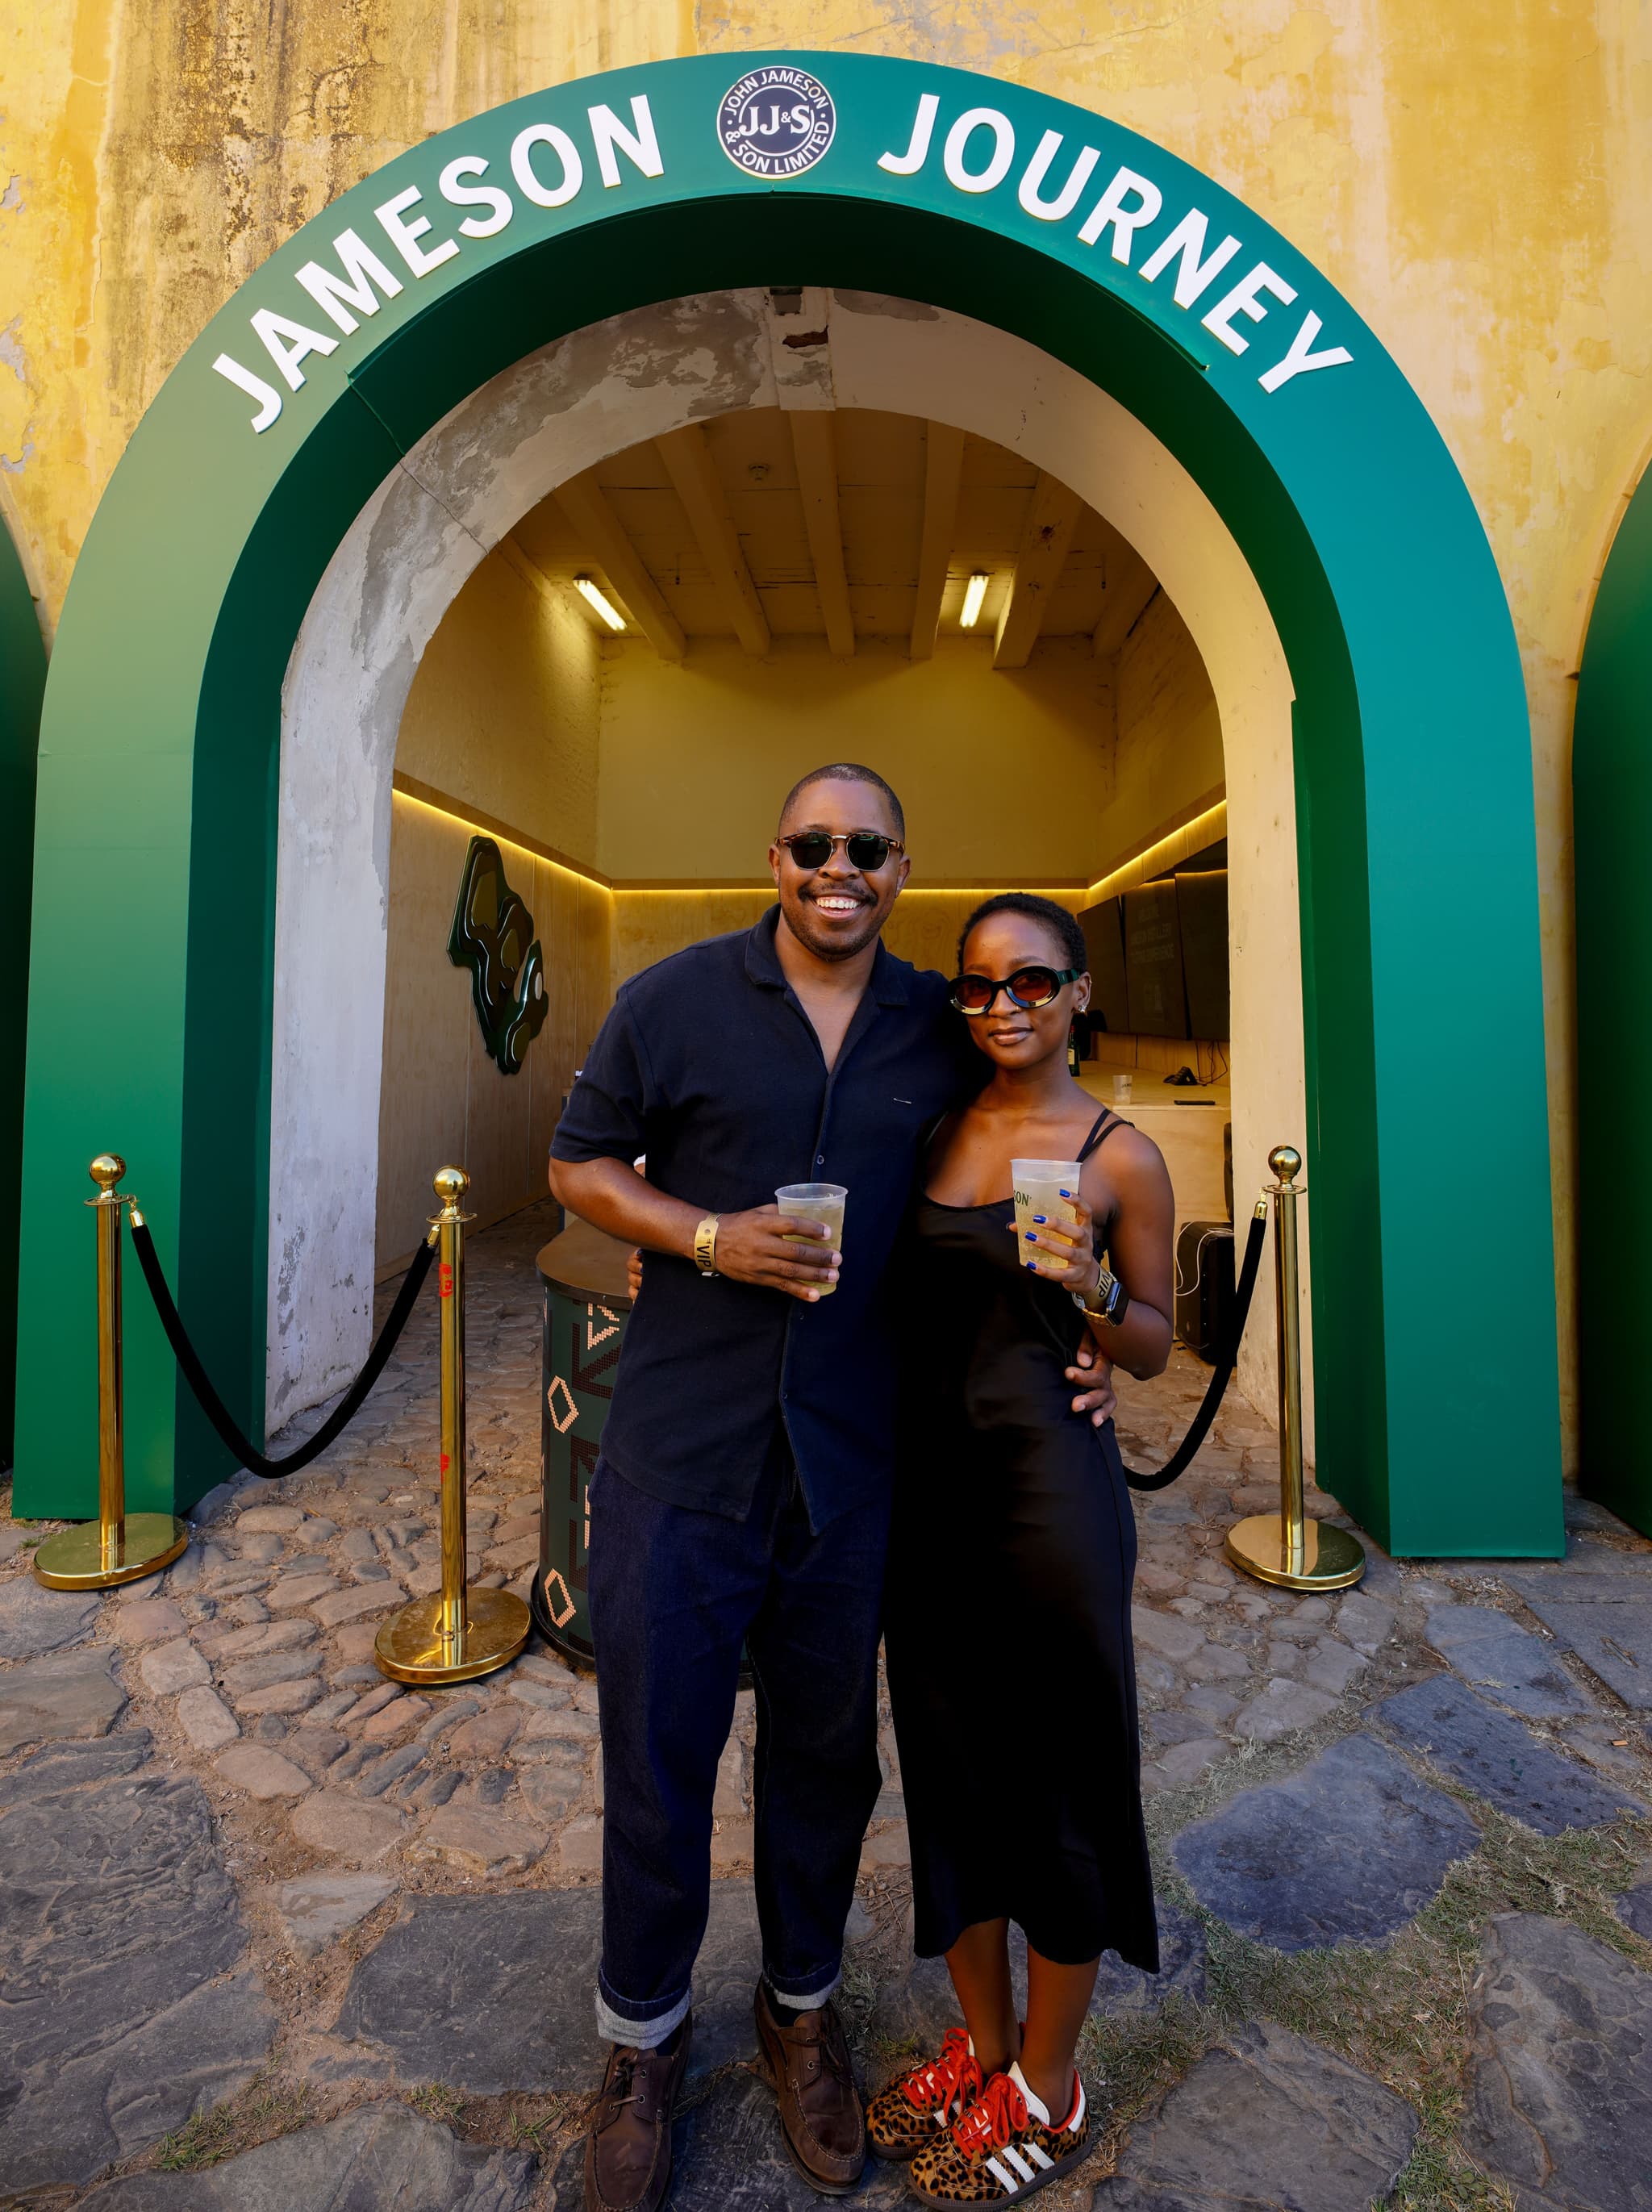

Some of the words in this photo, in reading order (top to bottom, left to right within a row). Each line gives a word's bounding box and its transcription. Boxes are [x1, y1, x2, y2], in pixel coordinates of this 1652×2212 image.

[724, 76, 759, 116] JOHN
[761, 69, 829, 110] JAMESON
[738, 104, 811, 136] JJ&S
[725, 130, 741, 145] &
[774, 121, 829, 173] LIMITED
[732, 144, 770, 173] SON
[211, 94, 665, 434] JAMESON
[877, 93, 1354, 394] JOURNEY
[696, 1245, 711, 1267] VIP
[1099, 1274, 1110, 1298] VIP
